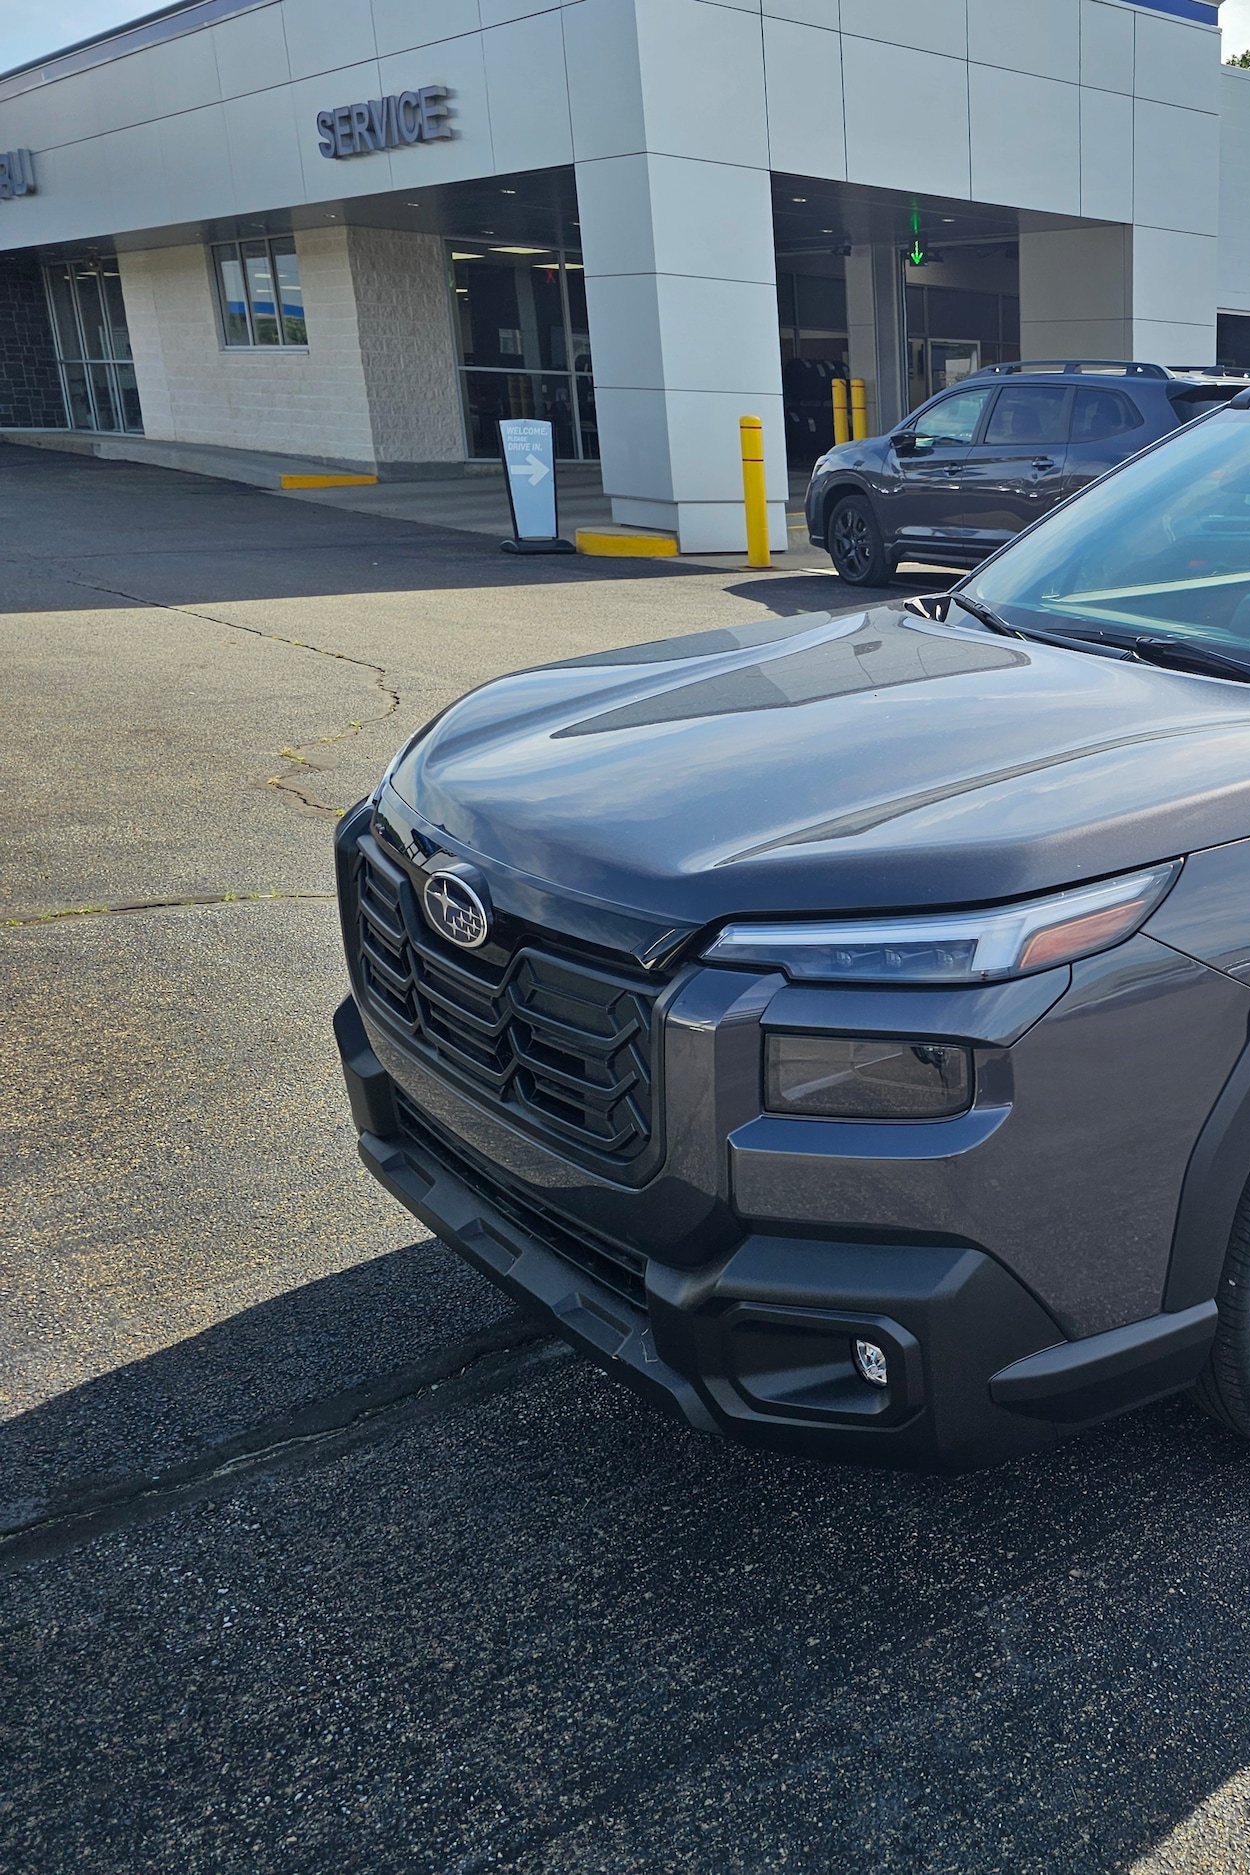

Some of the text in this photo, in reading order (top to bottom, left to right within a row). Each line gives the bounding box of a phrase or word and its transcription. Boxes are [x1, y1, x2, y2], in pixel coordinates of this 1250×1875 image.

[316, 85, 452, 159] SERVICE
[506, 426, 548, 436] WELCOME.
[508, 442, 543, 452] DRIVE IN.
